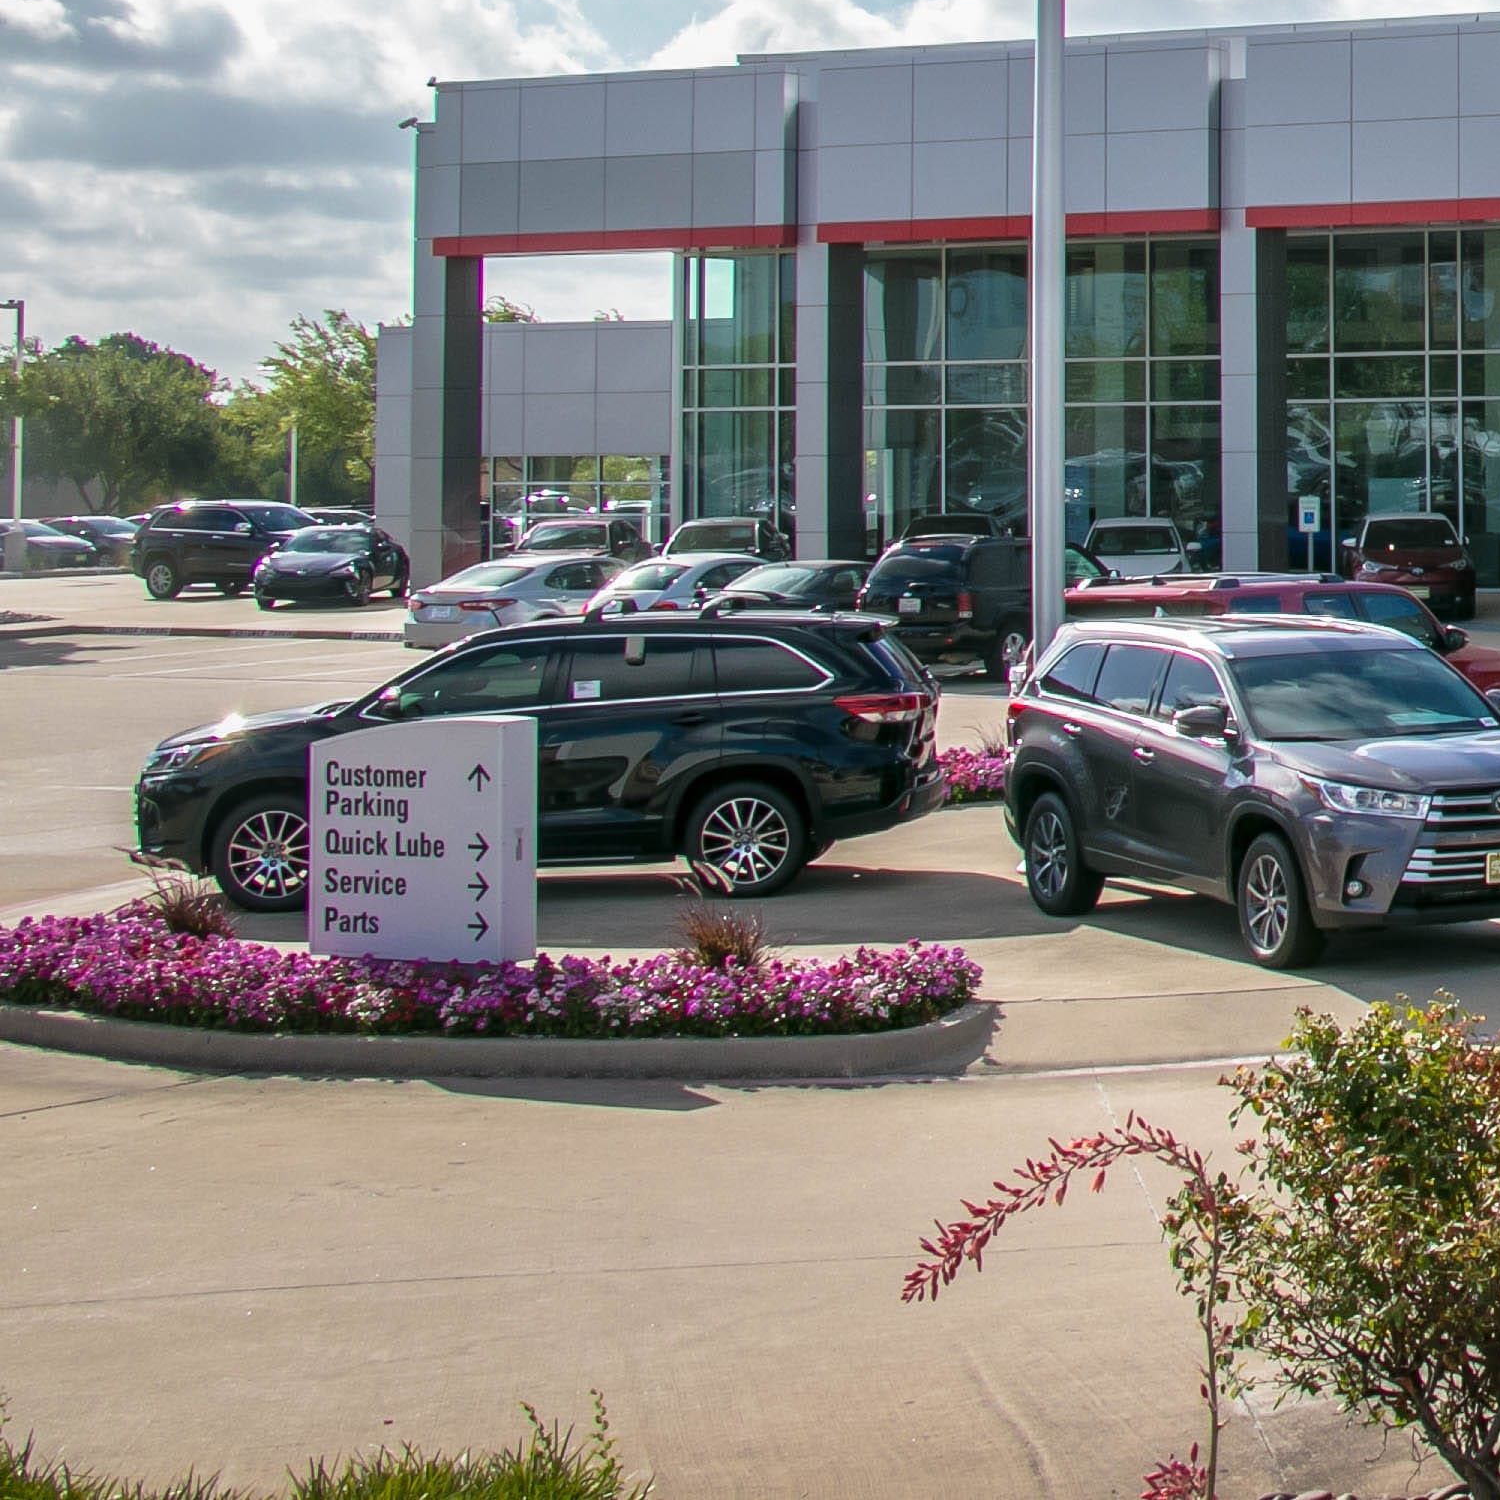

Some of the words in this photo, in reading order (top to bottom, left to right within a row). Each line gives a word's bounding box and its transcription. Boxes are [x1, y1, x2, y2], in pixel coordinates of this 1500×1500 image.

[326, 760, 427, 788] Customer
[326, 790, 409, 824] Parking
[325, 828, 388, 856] Quick
[395, 831, 445, 858] Lube
[324, 867, 408, 896] Service
[324, 906, 380, 934] Parts
